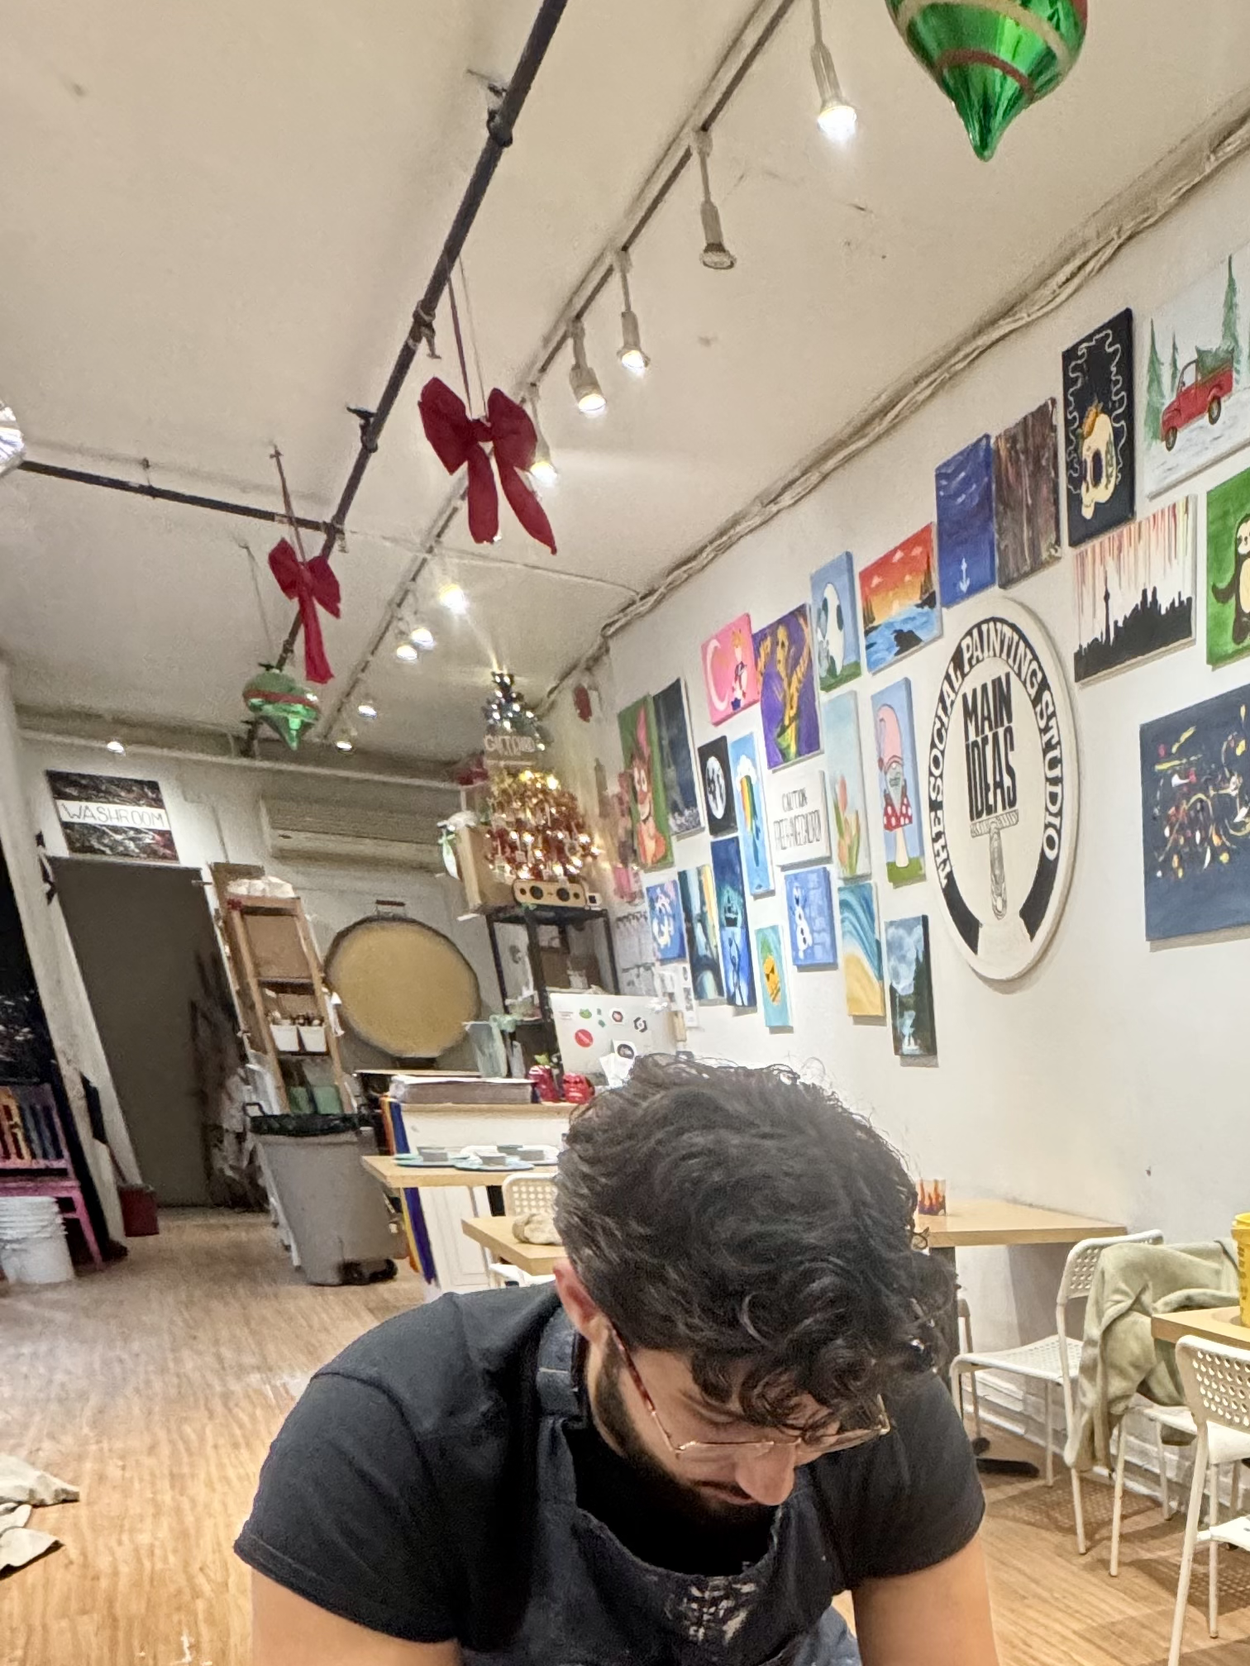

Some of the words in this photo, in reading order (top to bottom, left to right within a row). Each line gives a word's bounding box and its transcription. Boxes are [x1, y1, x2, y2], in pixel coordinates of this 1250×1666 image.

[960, 621, 1043, 700] PAINTING
[928, 660, 963, 803] SOCIAL
[961, 670, 1014, 743] MAIN
[965, 724, 1018, 822] IDEAS
[1034, 689, 1064, 861] STUDIO
[61, 802, 166, 828] WASHROOM
[929, 809, 952, 889] THE
